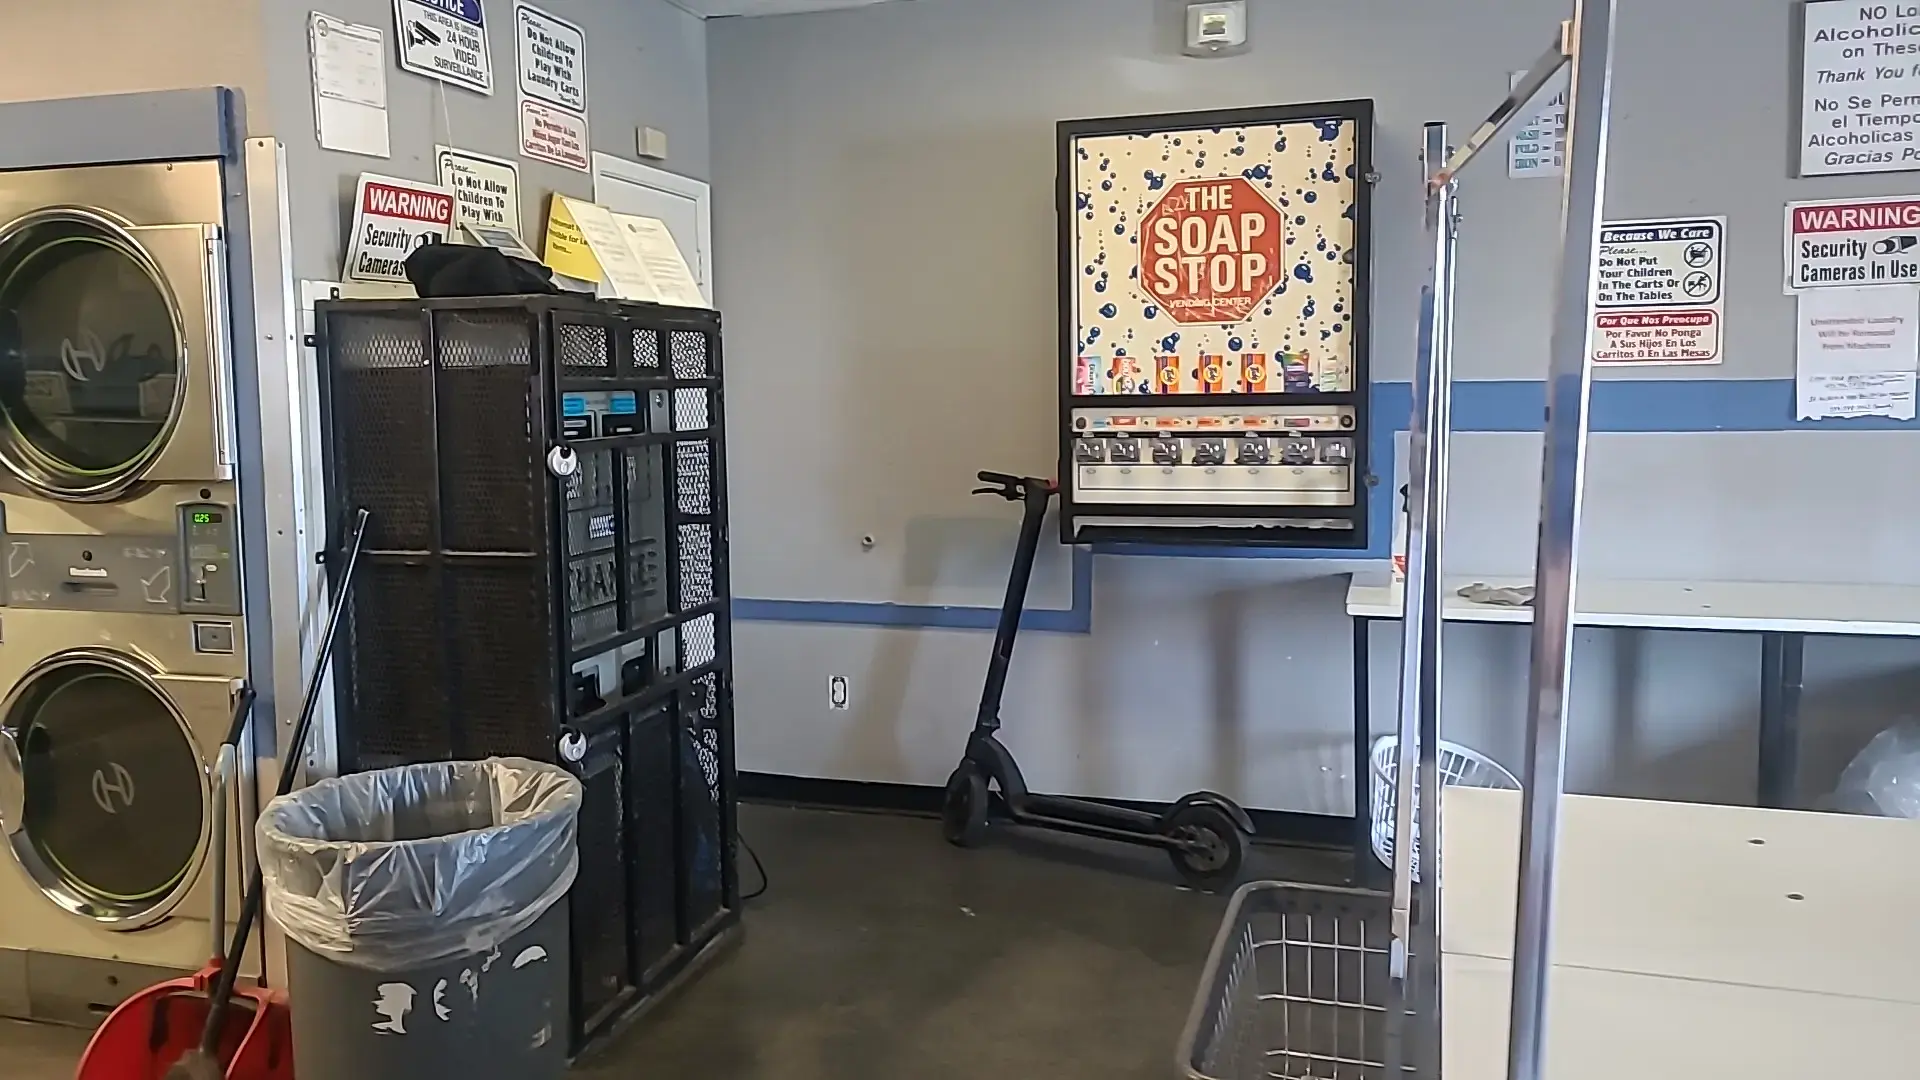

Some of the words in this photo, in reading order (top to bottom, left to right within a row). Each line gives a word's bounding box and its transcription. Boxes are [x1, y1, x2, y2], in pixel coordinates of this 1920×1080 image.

[423, 10, 437, 22] THIS
[1859, 6, 1887, 21] NO
[1896, 5, 1920, 18] Lo
[446, 29, 457, 44] 24
[459, 33, 480, 53] HOUR
[527, 26, 537, 40] Do
[539, 31, 553, 47] Not
[555, 38, 576, 56] Allow
[1842, 47, 1865, 59] on
[1873, 42, 1920, 57] Thes
[453, 47, 477, 67] VIDEO
[532, 43, 563, 65] Children
[565, 55, 573, 68] To
[434, 56, 484, 82] SURVEILLANCE
[535, 58, 551, 75] Play
[553, 65, 572, 81] With
[1817, 67, 1866, 85] Thank
[1875, 65, 1904, 80] You
[1912, 63, 1920, 78] f
[527, 68, 558, 92] Laundry
[560, 81, 579, 97] Carts
[1814, 97, 1839, 112] No
[1848, 95, 1872, 110] Se
[1831, 115, 1848, 129] el
[1808, 130, 1913, 148] Alcoholicas
[1824, 150, 1893, 166] Gracias
[466, 175, 481, 190] Not
[484, 179, 508, 195] Allow
[369, 187, 449, 221] WARNING
[458, 189, 493, 207] Children
[496, 196, 505, 209] To
[1184, 185, 1233, 212] THE
[461, 205, 481, 224] Play
[484, 209, 504, 223] With
[1800, 205, 1920, 230] WARNING
[364, 223, 413, 253] Security
[1154, 212, 1266, 256] SOAP
[1603, 230, 1654, 242] Because
[1658, 229, 1677, 240] We
[1681, 228, 1710, 239] Care
[1801, 238, 1868, 260] Security
[358, 252, 406, 276] Cameras
[1600, 258, 1613, 267] Do
[1616, 257, 1636, 267] Not
[1639, 256, 1658, 266] Put
[1801, 264, 1866, 282] Cameras
[1871, 261, 1885, 279] In
[1891, 260, 1918, 278] Use
[1154, 253, 1267, 295] STOP
[1600, 269, 1623, 279] Your
[1627, 268, 1673, 278] Children
[1599, 281, 1609, 290] In
[1612, 280, 1632, 290] The
[1635, 280, 1664, 290] Carts
[1667, 279, 1680, 288] Or
[1170, 298, 1211, 309] VENDING
[1213, 297, 1252, 307] CENTER
[1599, 292, 1613, 301] On
[1616, 292, 1635, 301] The
[1638, 291, 1673, 300] Tables
[1600, 317, 1618, 326] Por
[1620, 317, 1639, 326] Que
[1641, 316, 1660, 325] Nos
[1662, 315, 1710, 324] Preocupa
[1606, 330, 1622, 339] Por
[1625, 329, 1652, 339] Favor
[1655, 329, 1668, 338] No
[1671, 328, 1702, 339] Ponga
[1610, 340, 1617, 349] A
[1620, 339, 1637, 349] Sus
[1639, 338, 1662, 349] Hijos
[1666, 338, 1677, 348] En
[1680, 338, 1697, 347] Los
[1596, 349, 1635, 360] Carritos
[1647, 349, 1660, 358] En
[1662, 348, 1678, 358] Las
[1681, 348, 1711, 357] Mesas
